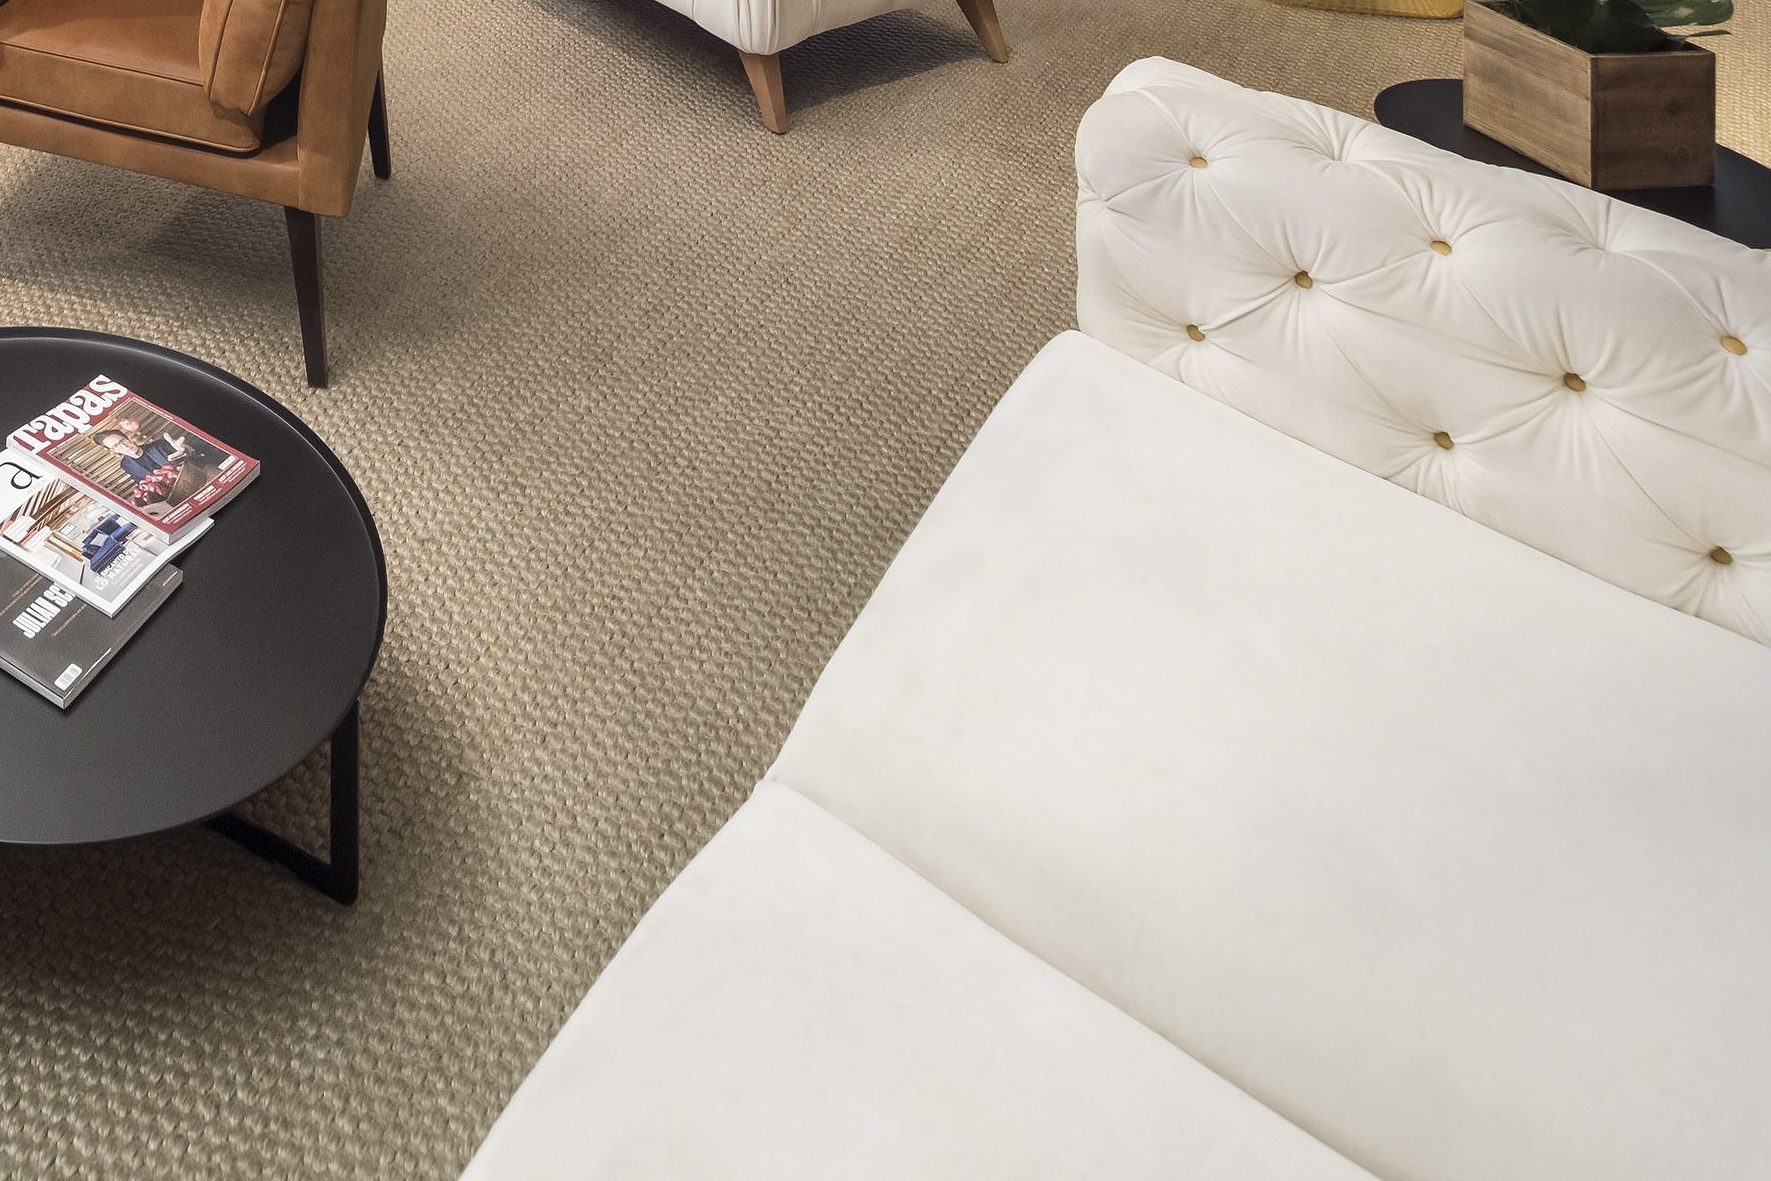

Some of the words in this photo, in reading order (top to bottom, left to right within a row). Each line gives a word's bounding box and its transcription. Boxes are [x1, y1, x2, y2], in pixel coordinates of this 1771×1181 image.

[100, 552, 125, 577] ENCANTO
[95, 579, 109, 590] LO
[12, 595, 62, 639] JULIAN
[43, 582, 76, 608] SC
